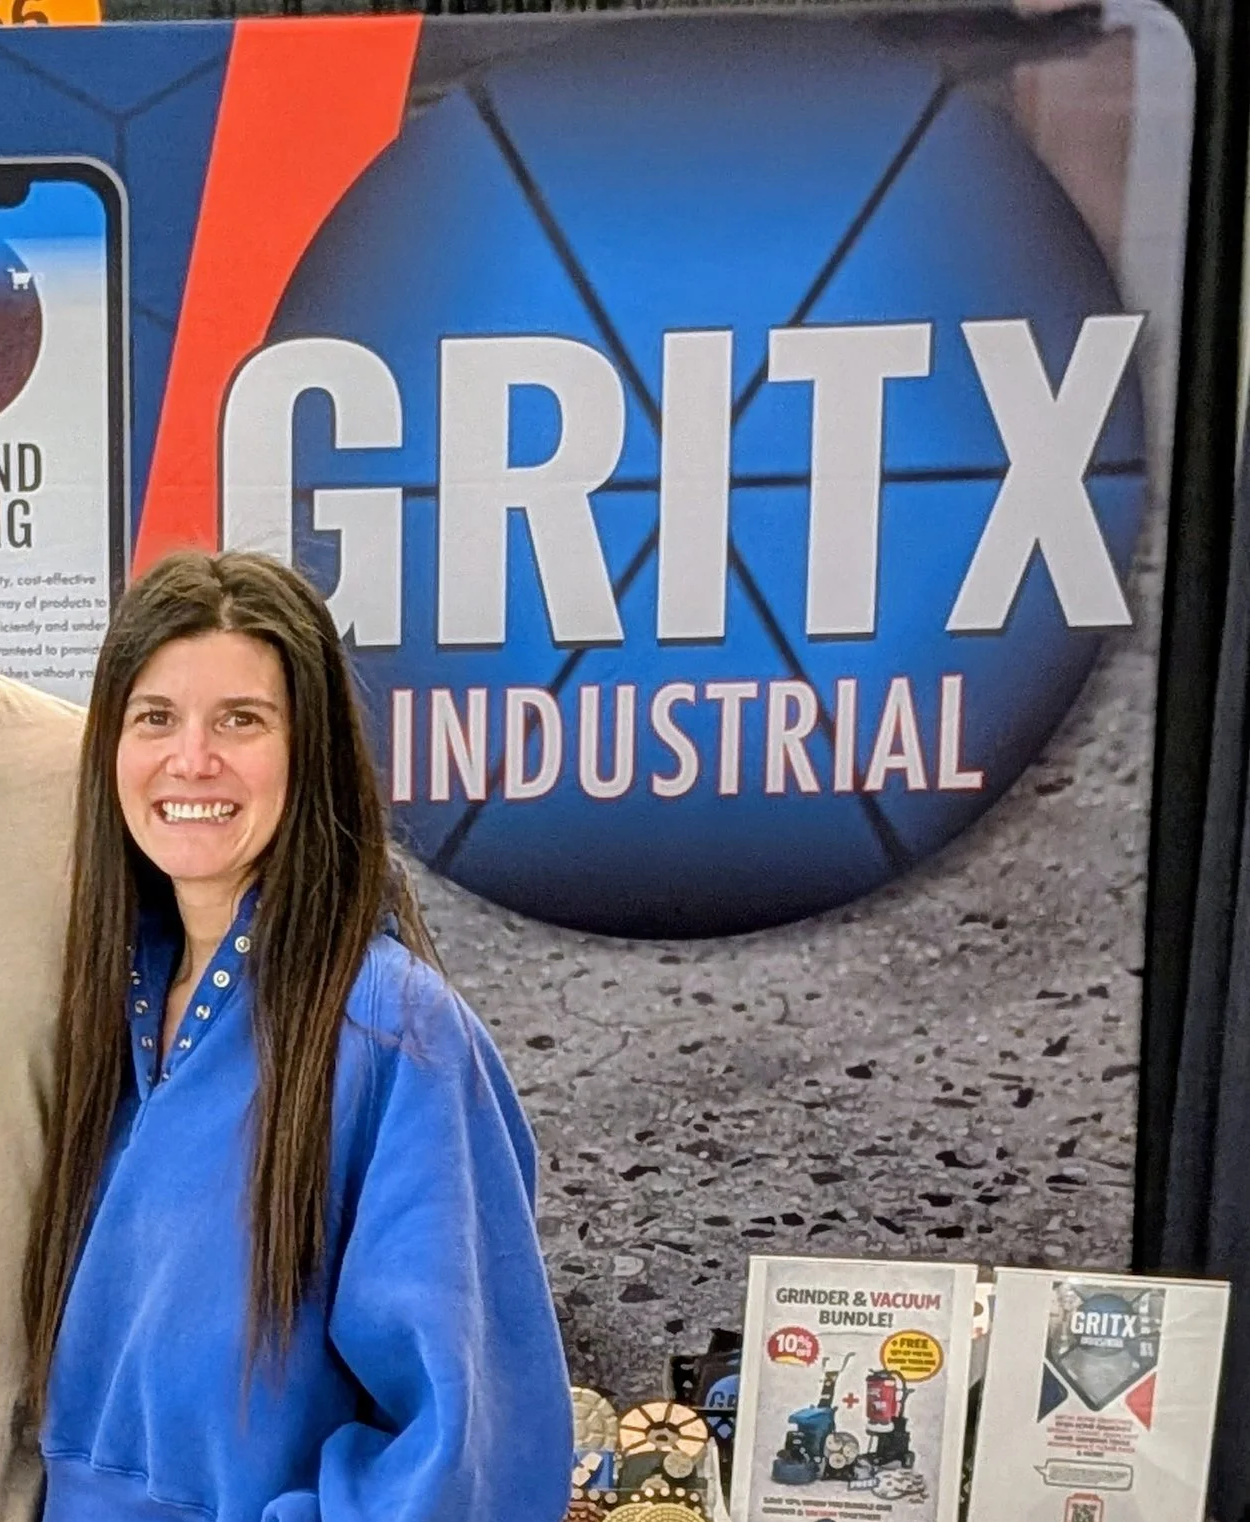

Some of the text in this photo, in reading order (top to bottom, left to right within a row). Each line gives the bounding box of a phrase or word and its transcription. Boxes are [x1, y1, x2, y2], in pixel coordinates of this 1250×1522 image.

[220, 313, 1145, 648] GRITX
[17, 572, 96, 587] cost-effective
[24, 596, 37, 609] of
[40, 596, 92, 612] products
[95, 598, 107, 608] to
[45, 620, 68, 632] and
[45, 645, 57, 656] to
[31, 666, 75, 678] without
[78, 670, 94, 679] yo
[391, 673, 985, 802] INDUSTRIAL
[776, 1287, 942, 1311] GRINDER & VACUUM
[818, 1310, 894, 1329] BUNDLE!
[1070, 1311, 1138, 1339] GRITX
[775, 1333, 813, 1353] 10%
[900, 1337, 929, 1350] FREE
